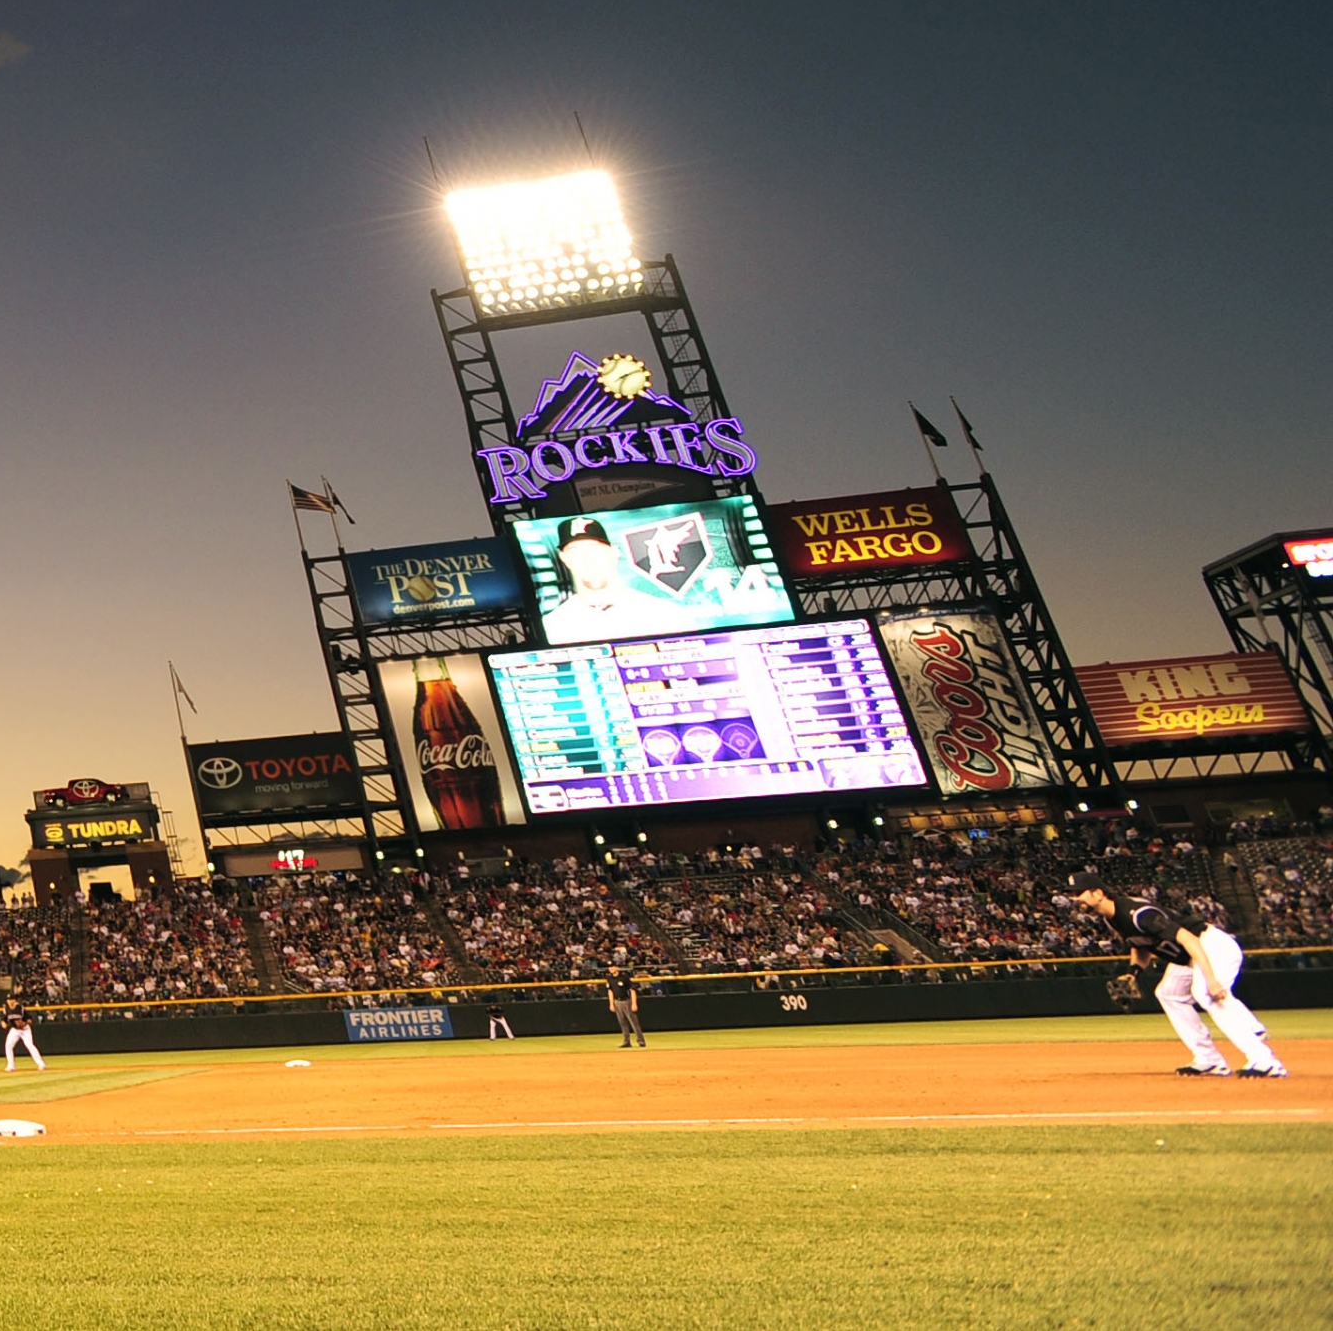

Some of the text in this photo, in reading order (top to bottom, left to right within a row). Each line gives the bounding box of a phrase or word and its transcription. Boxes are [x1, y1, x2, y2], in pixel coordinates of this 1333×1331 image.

[477, 418, 757, 503] ROCKIES
[792, 503, 933, 537] WELLS
[805, 531, 942, 565] FARGO
[371, 553, 494, 581] THE DENVER
[387, 572, 473, 603] POST
[393, 596, 476, 614] denverpost.com
[1117, 663, 1251, 703] KING
[910, 623, 1015, 790] Coors
[961, 630, 1051, 781] LIGHT
[1136, 702, 1264, 735] Soopers
[245, 754, 352, 780] TOYOTA
[417, 734, 496, 774] Coca-Cola
[255, 778, 329, 794] moving forward
[67, 819, 142, 838] TUNDRA
[349, 1009, 445, 1026] FRONTIER
[779, 994, 808, 1011] 390
[359, 1024, 443, 1039] AIRLINES
